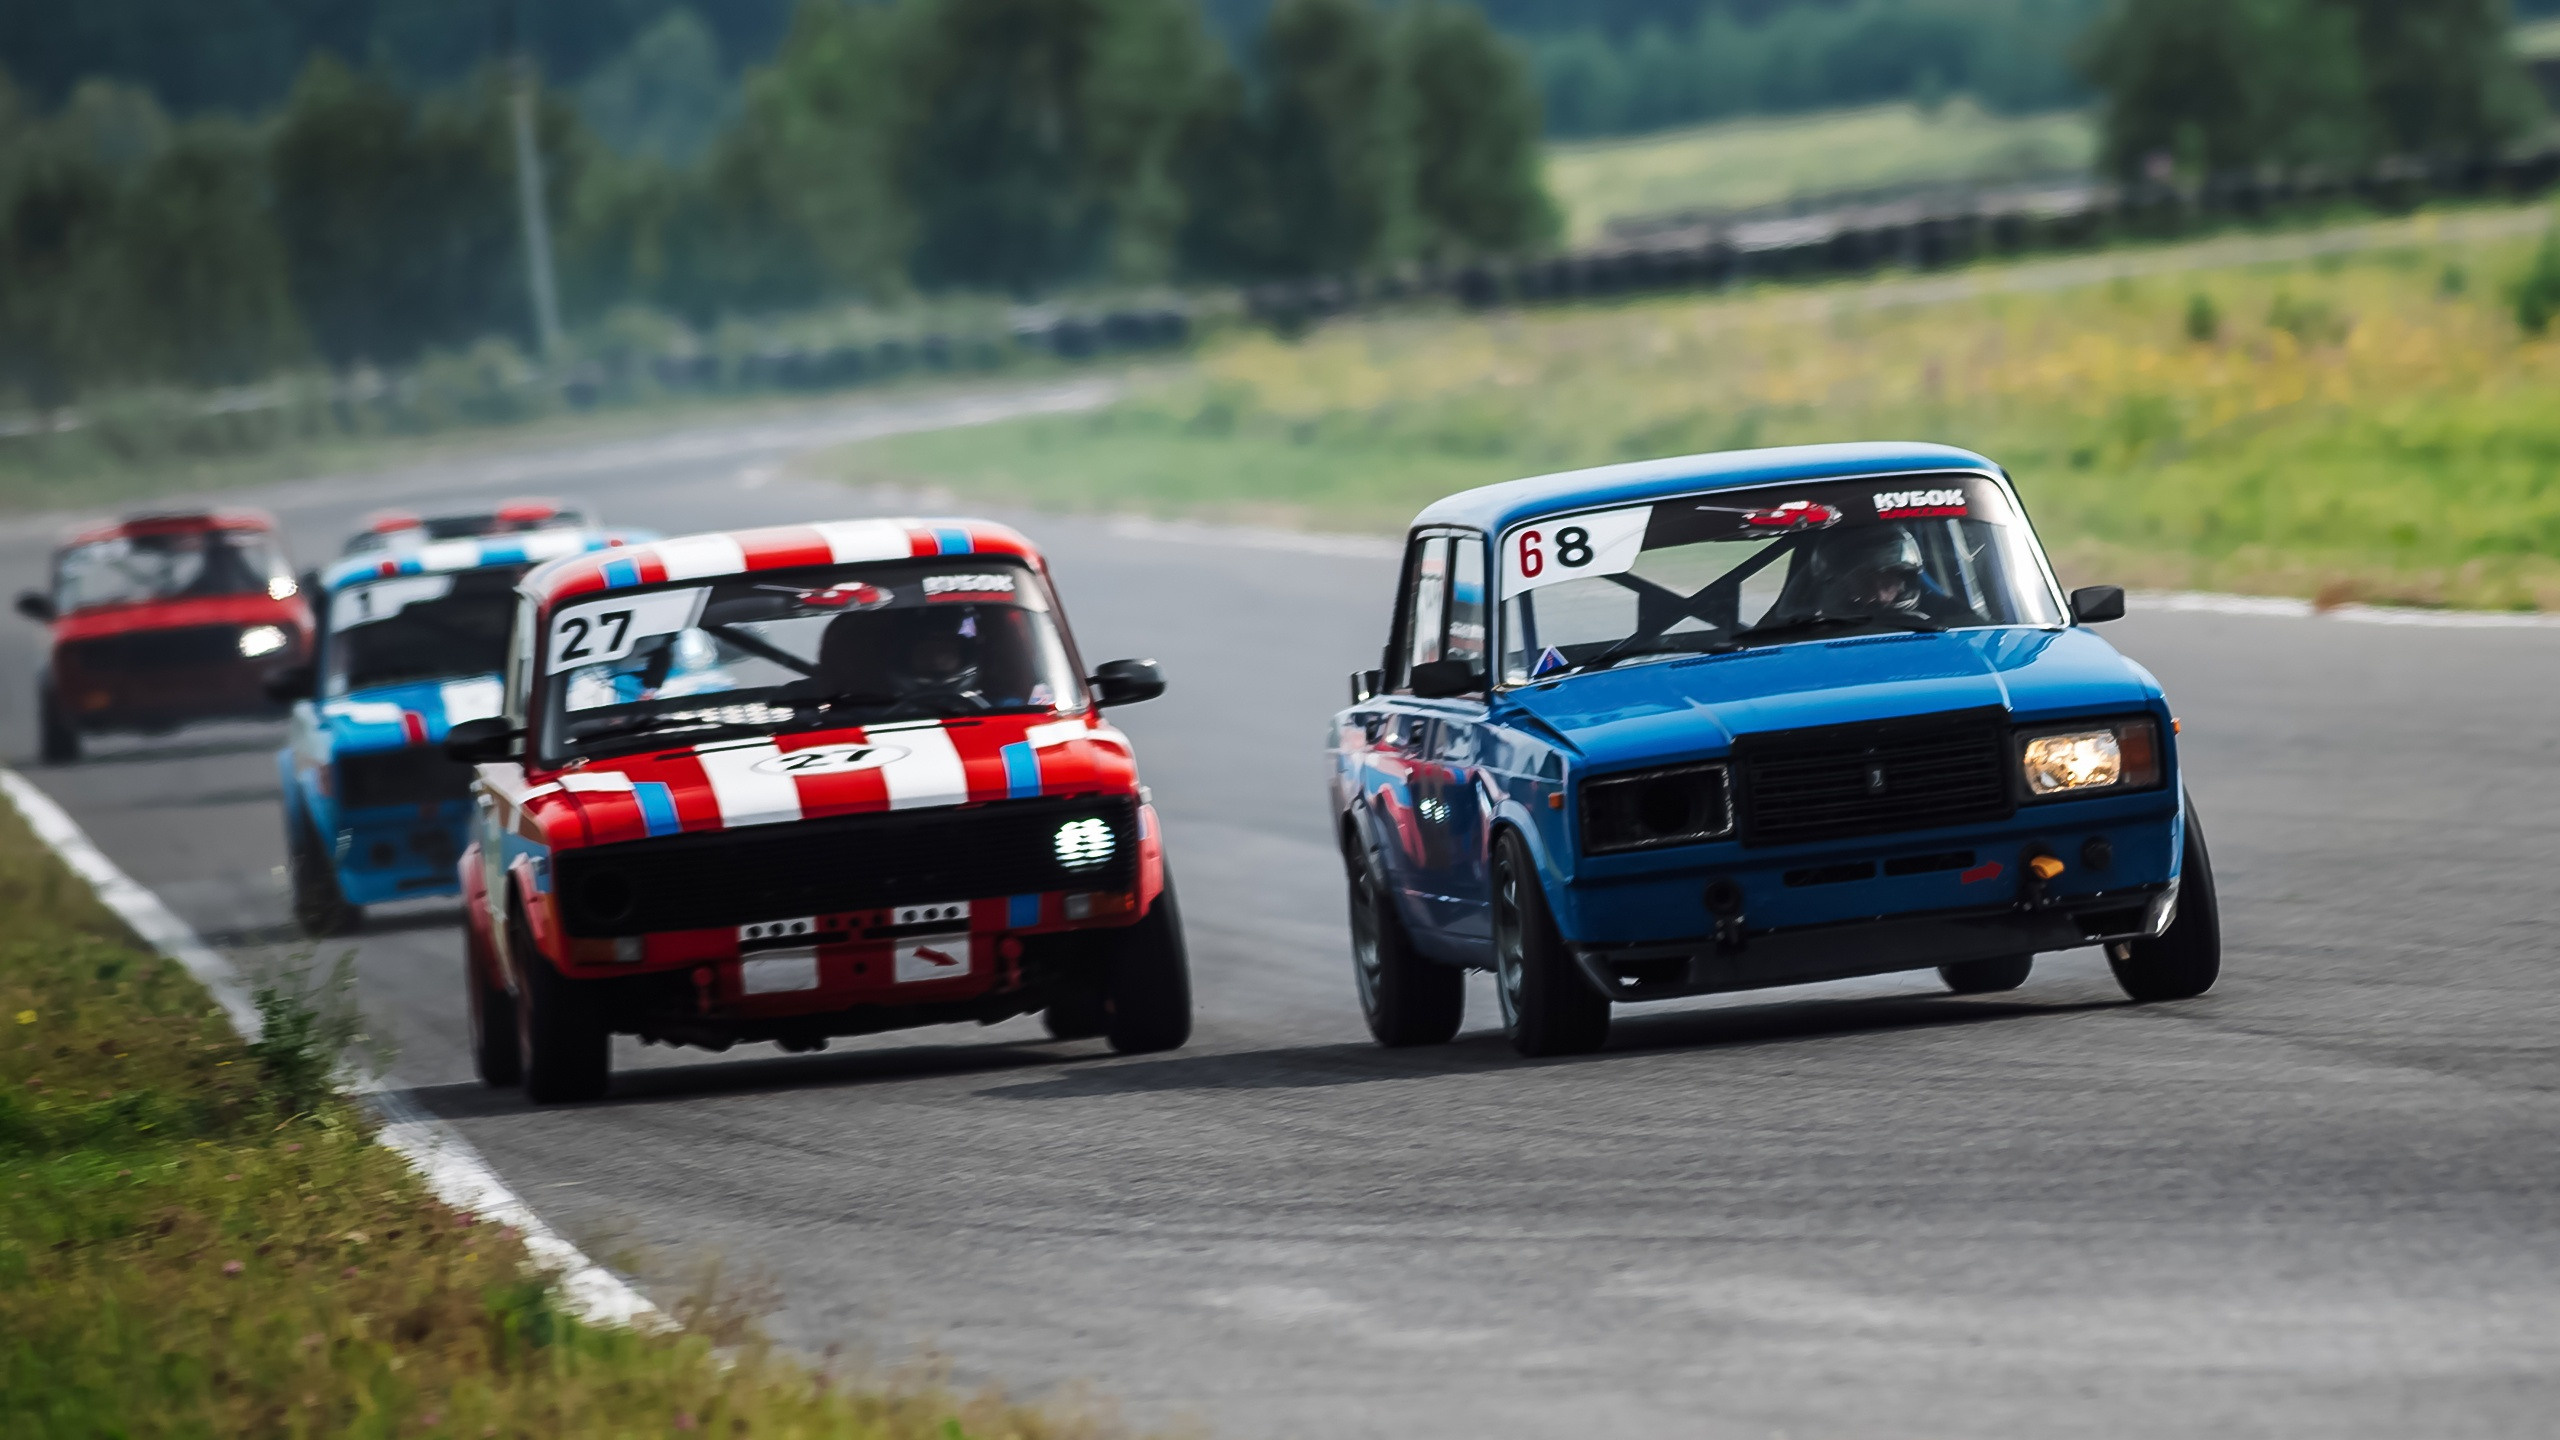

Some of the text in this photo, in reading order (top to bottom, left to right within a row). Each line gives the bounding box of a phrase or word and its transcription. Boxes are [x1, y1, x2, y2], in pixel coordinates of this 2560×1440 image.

[1873, 489, 1966, 512] КУБОК
[560, 609, 634, 661] 27
[779, 748, 876, 771] 27
